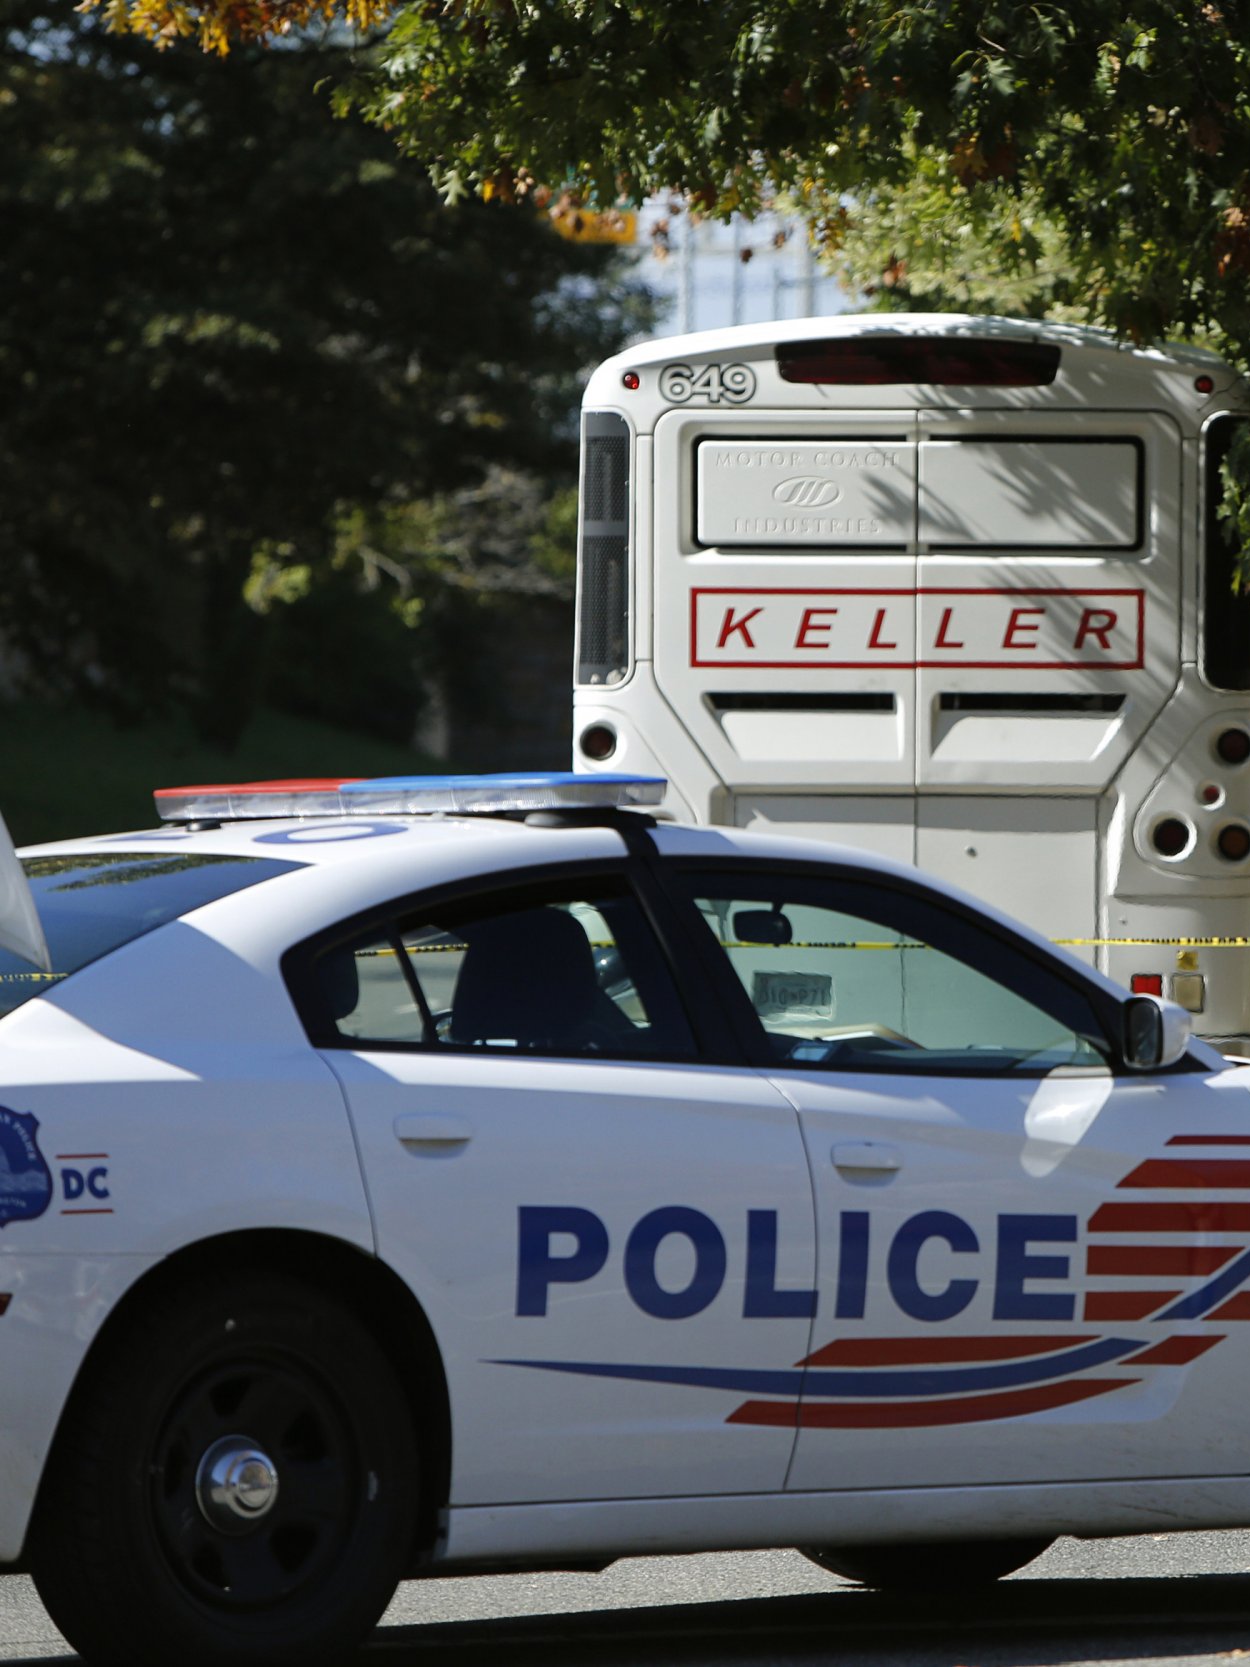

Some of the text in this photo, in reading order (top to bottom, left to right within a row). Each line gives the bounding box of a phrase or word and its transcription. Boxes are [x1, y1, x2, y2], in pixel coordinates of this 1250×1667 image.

[659, 363, 757, 404] 649
[715, 452, 899, 468] MOTOR COACH
[734, 518, 881, 534] INDUSTRIES
[715, 607, 1119, 650] KELLER
[61, 1166, 110, 1200] DC
[514, 1205, 1079, 1322] POLICE
